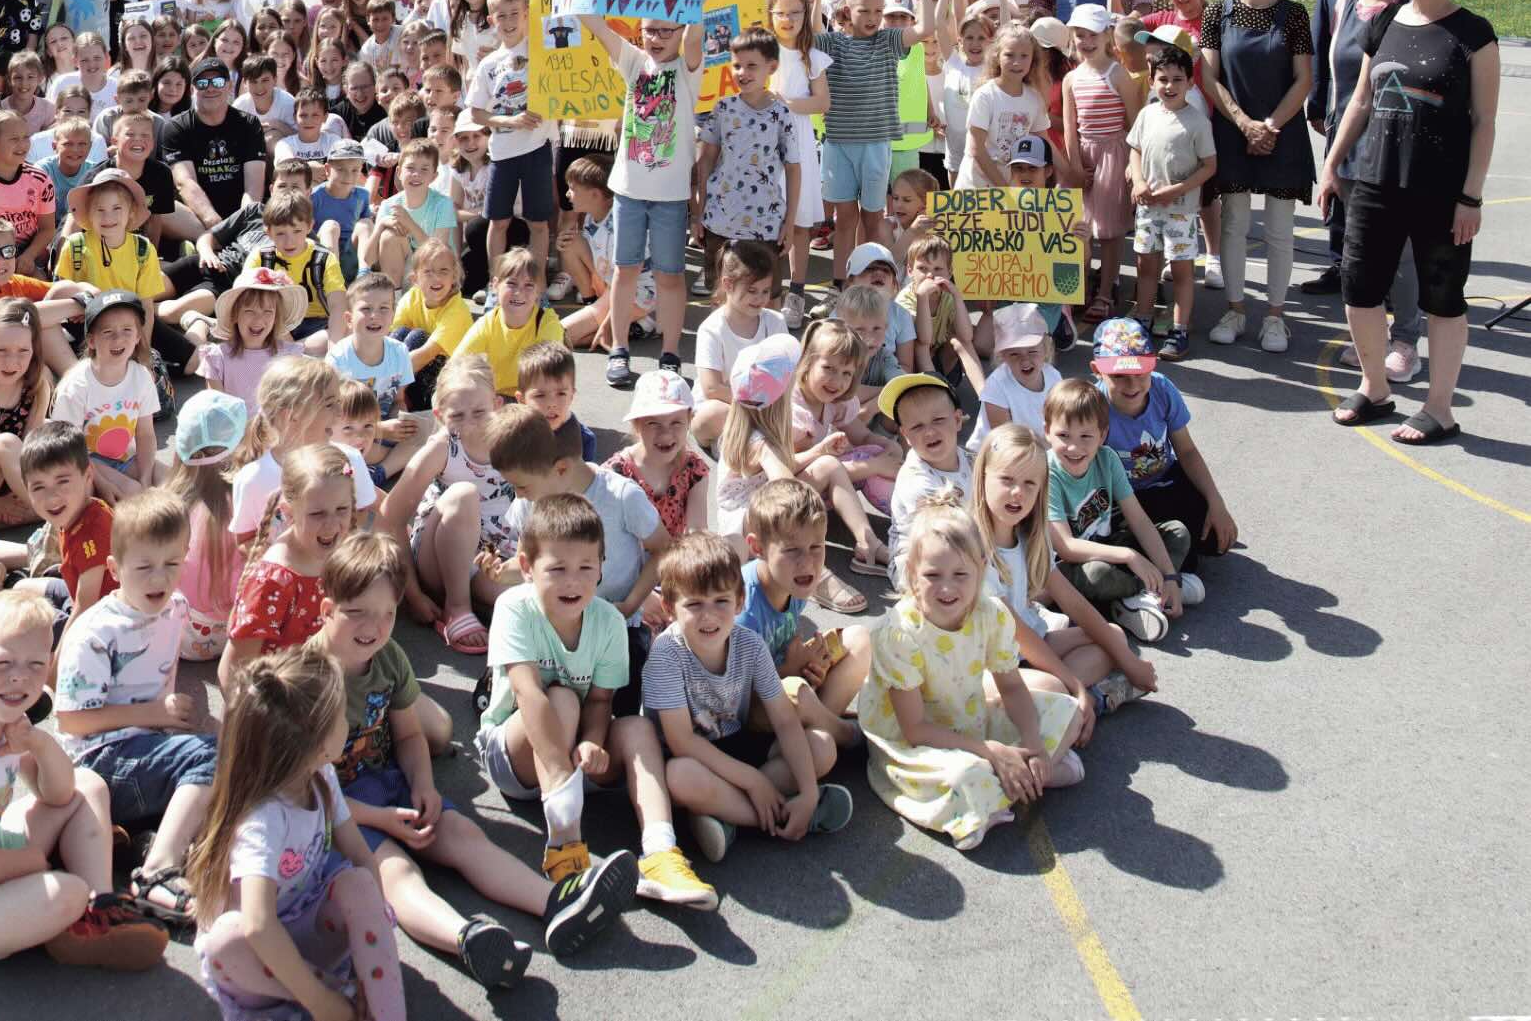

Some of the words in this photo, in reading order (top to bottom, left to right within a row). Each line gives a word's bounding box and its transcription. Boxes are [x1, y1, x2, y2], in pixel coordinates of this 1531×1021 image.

[933, 188, 1006, 213] DOBER
[1018, 188, 1073, 213] GLAS
[1000, 210, 1045, 232] TUDI
[1058, 212, 1075, 231] V
[1039, 232, 1077, 254] VAS
[966, 253, 1034, 272] SKUPAJ
[963, 272, 1049, 298] ZMOREMO
[102, 293, 122, 305] CAT
